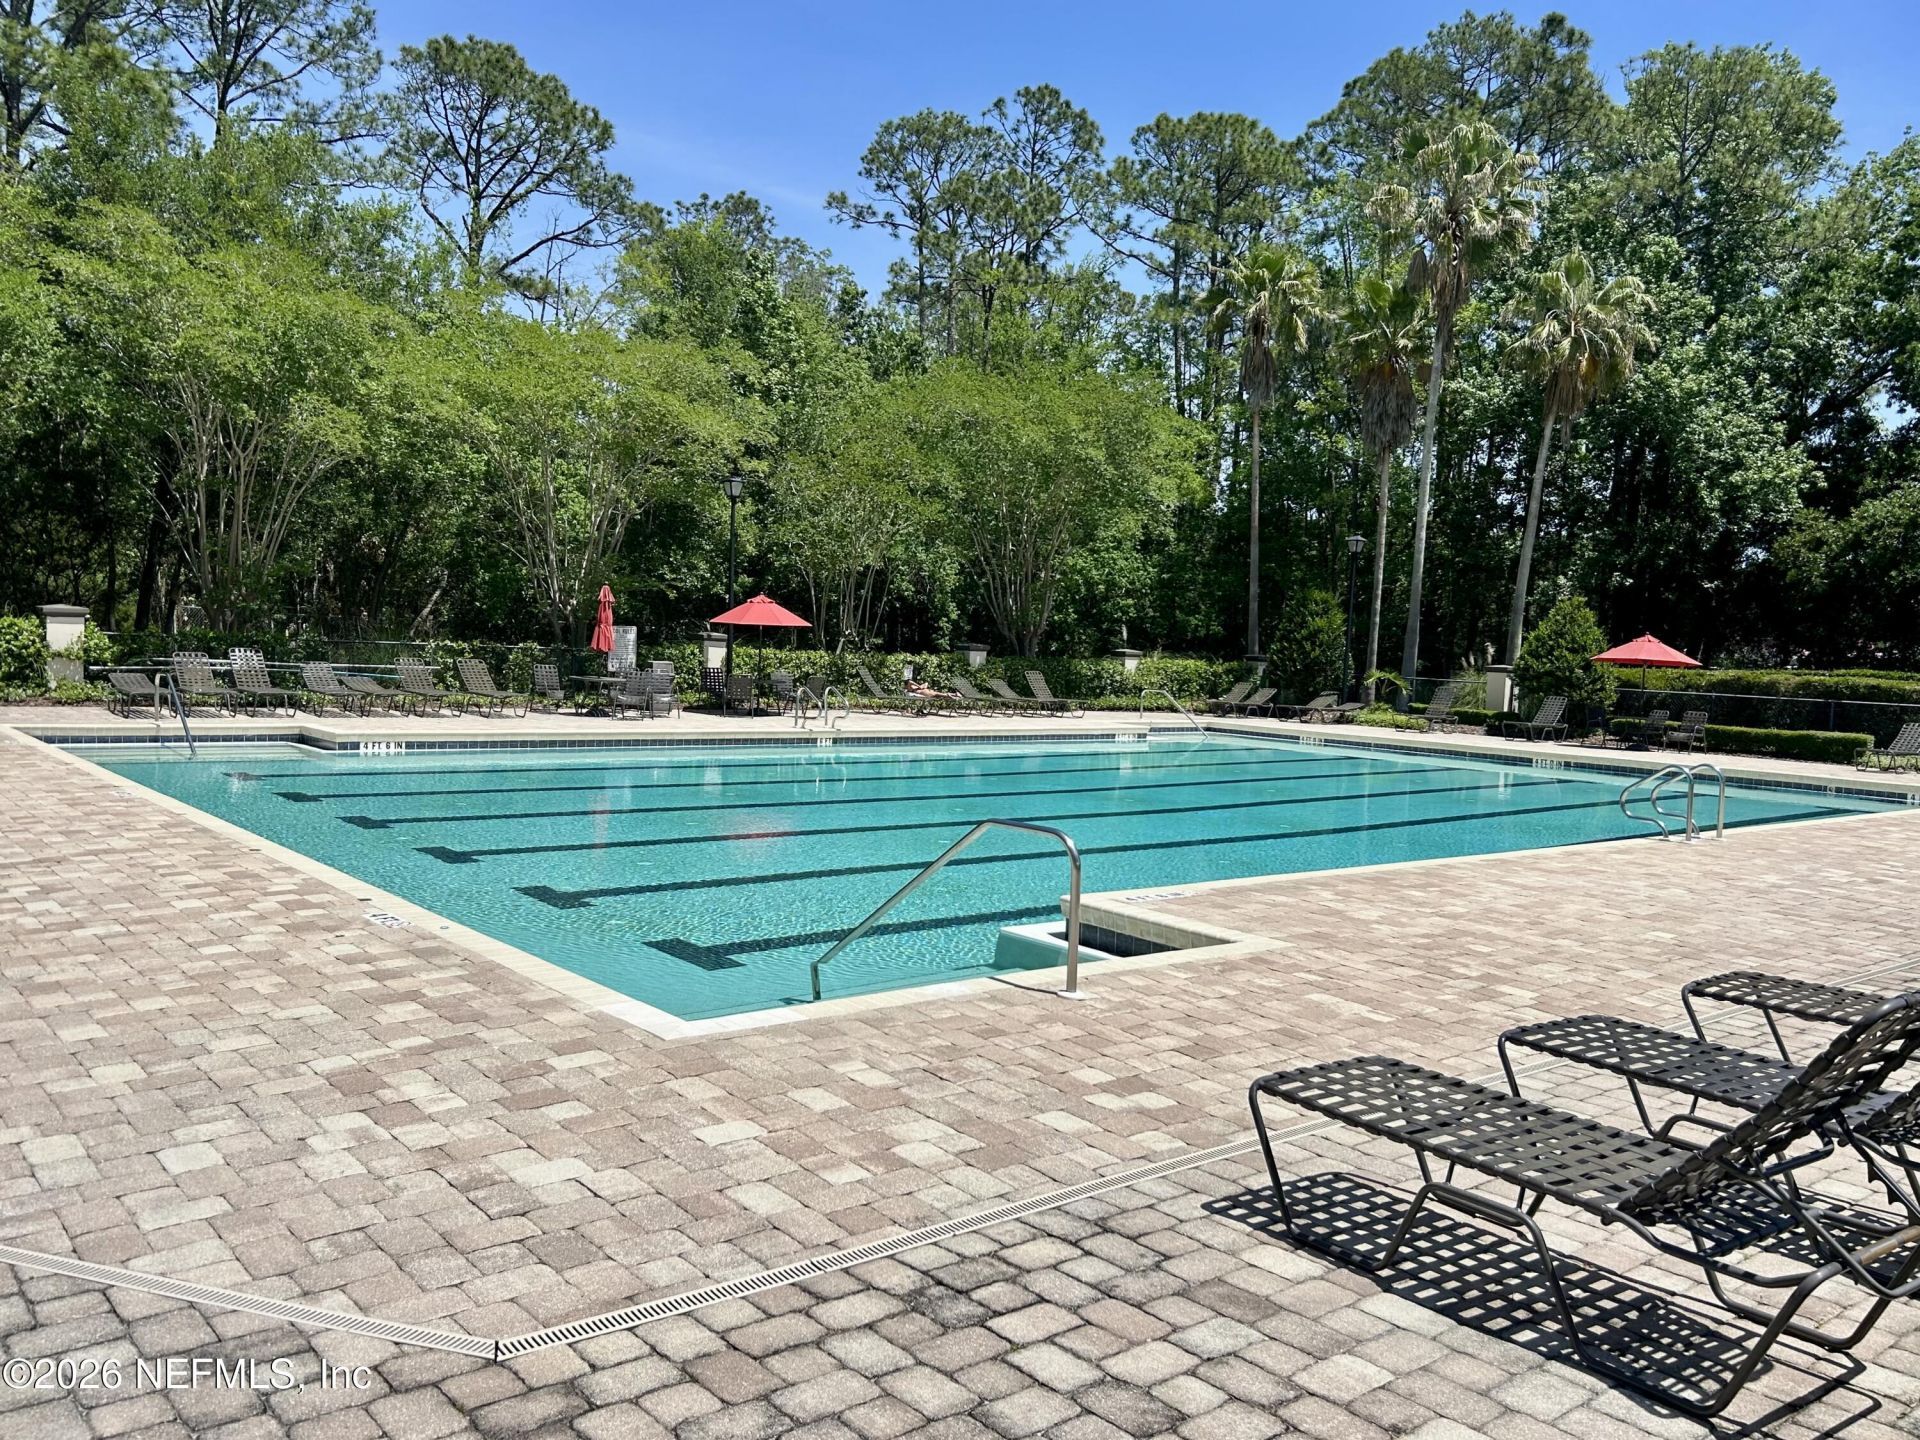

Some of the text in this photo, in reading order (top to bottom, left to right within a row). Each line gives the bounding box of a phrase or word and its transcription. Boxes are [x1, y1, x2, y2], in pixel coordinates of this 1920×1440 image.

[363, 741, 402, 749] 4 FT 6 IN
